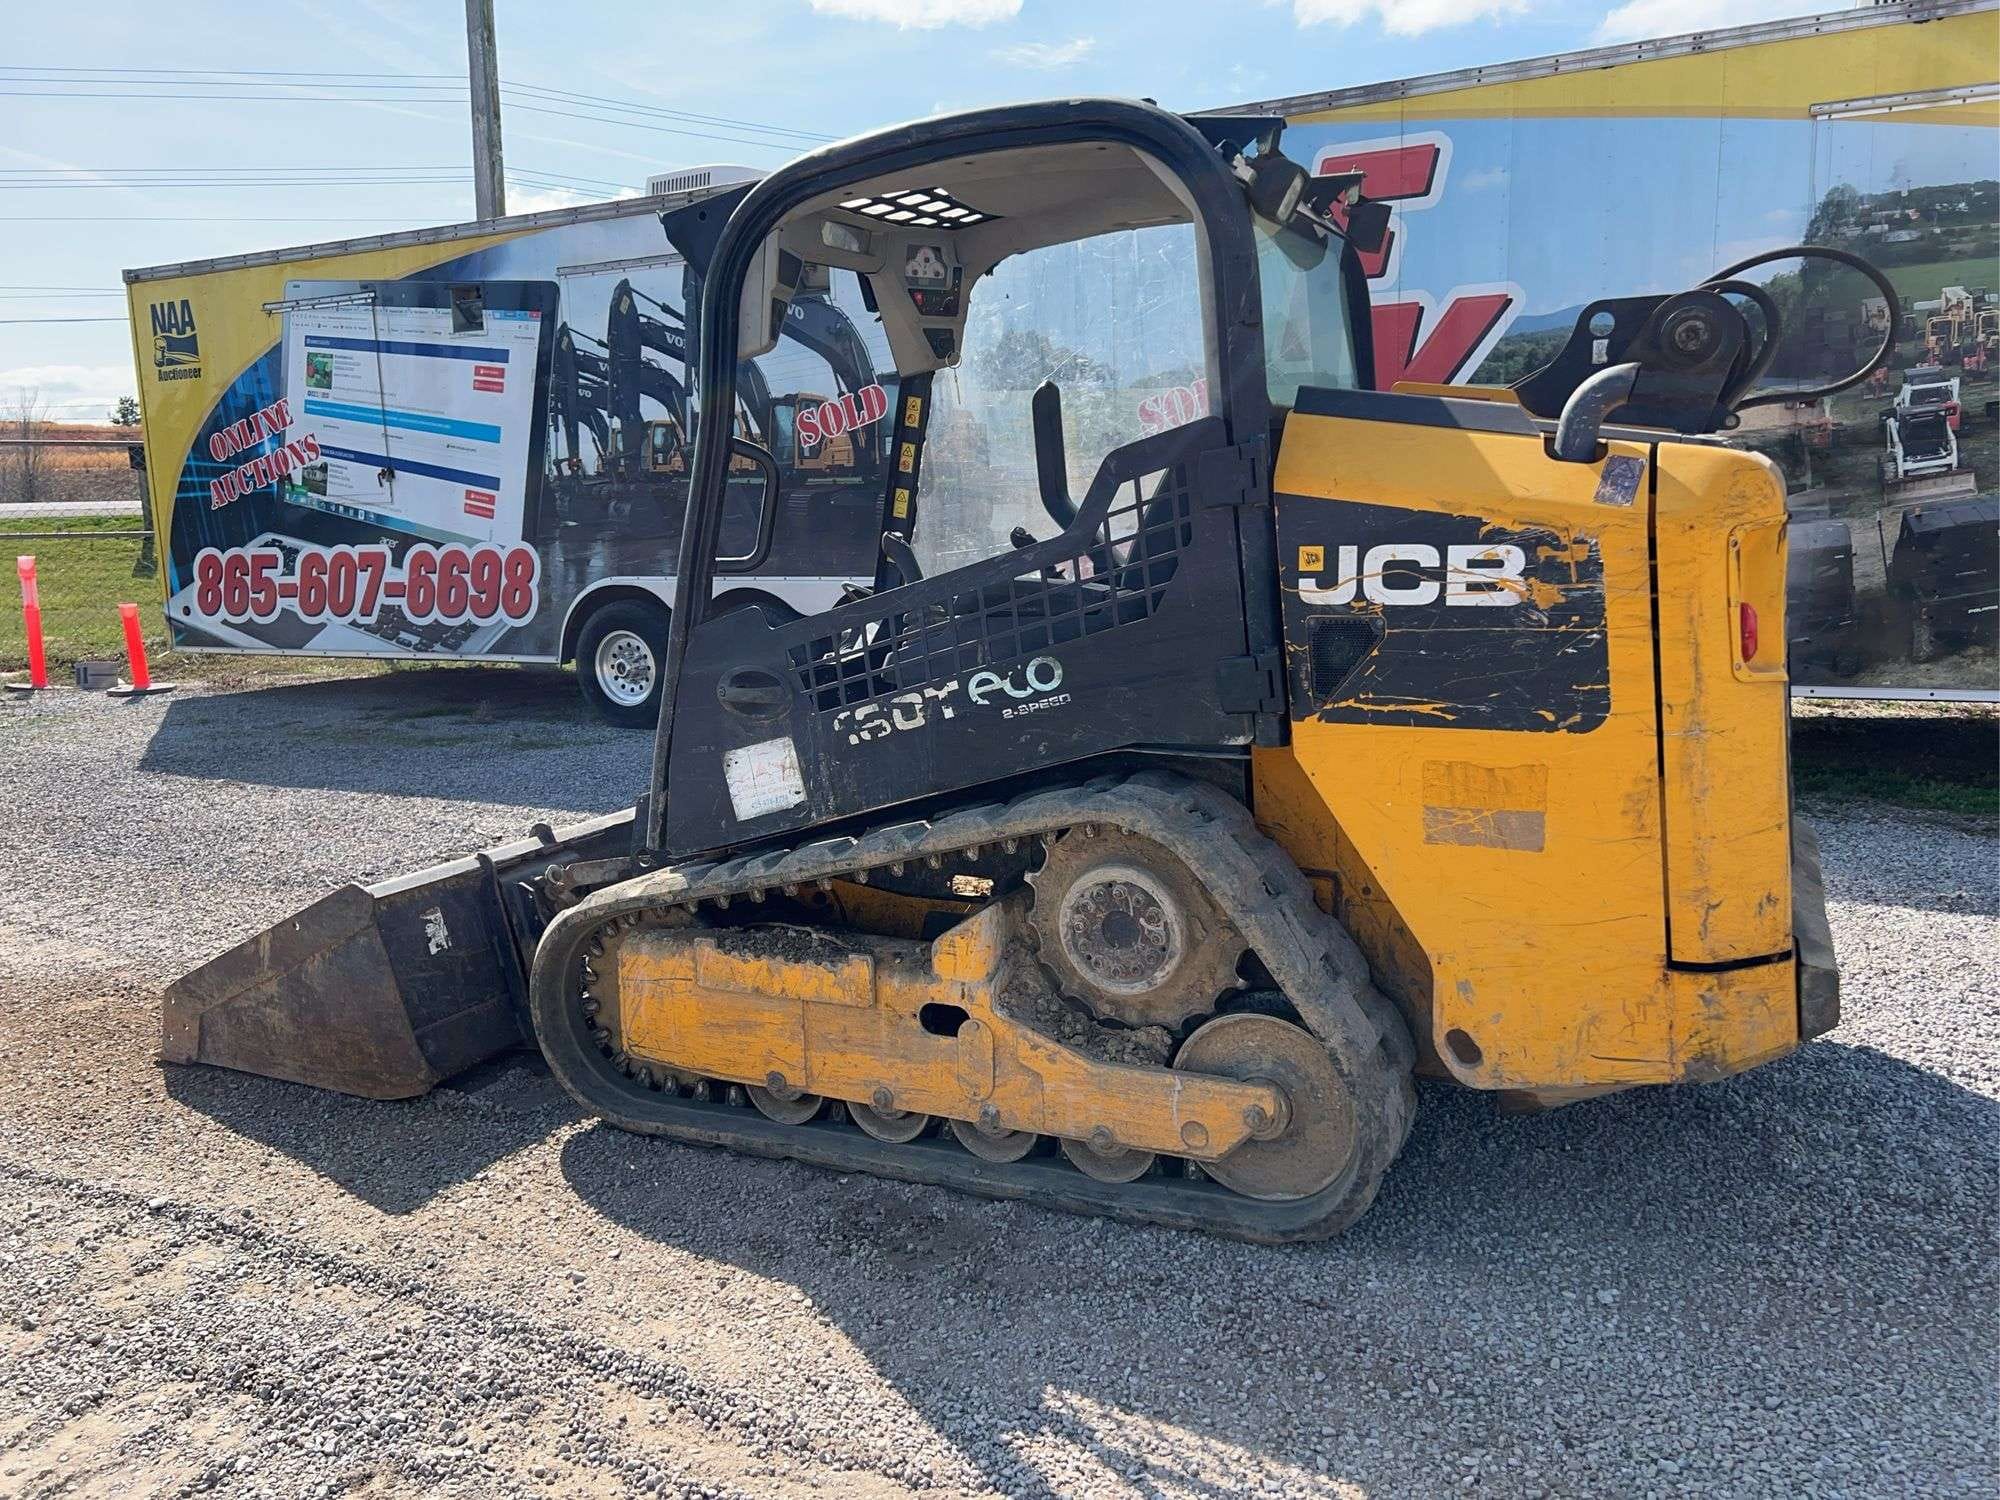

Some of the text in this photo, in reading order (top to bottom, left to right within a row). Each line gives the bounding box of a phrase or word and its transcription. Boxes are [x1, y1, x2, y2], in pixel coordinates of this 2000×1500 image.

[150, 299, 197, 337] NAA
[665, 331, 687, 349] VO
[158, 367, 202, 381] Auctioneer
[210, 397, 294, 461] ONLINE
[797, 384, 888, 448] SOLD
[210, 432, 320, 510] AUCTIONS
[196, 546, 536, 620] 865-607-6698
[1298, 544, 1527, 607] JCB
[1002, 693, 1072, 719] 2-SPEED
